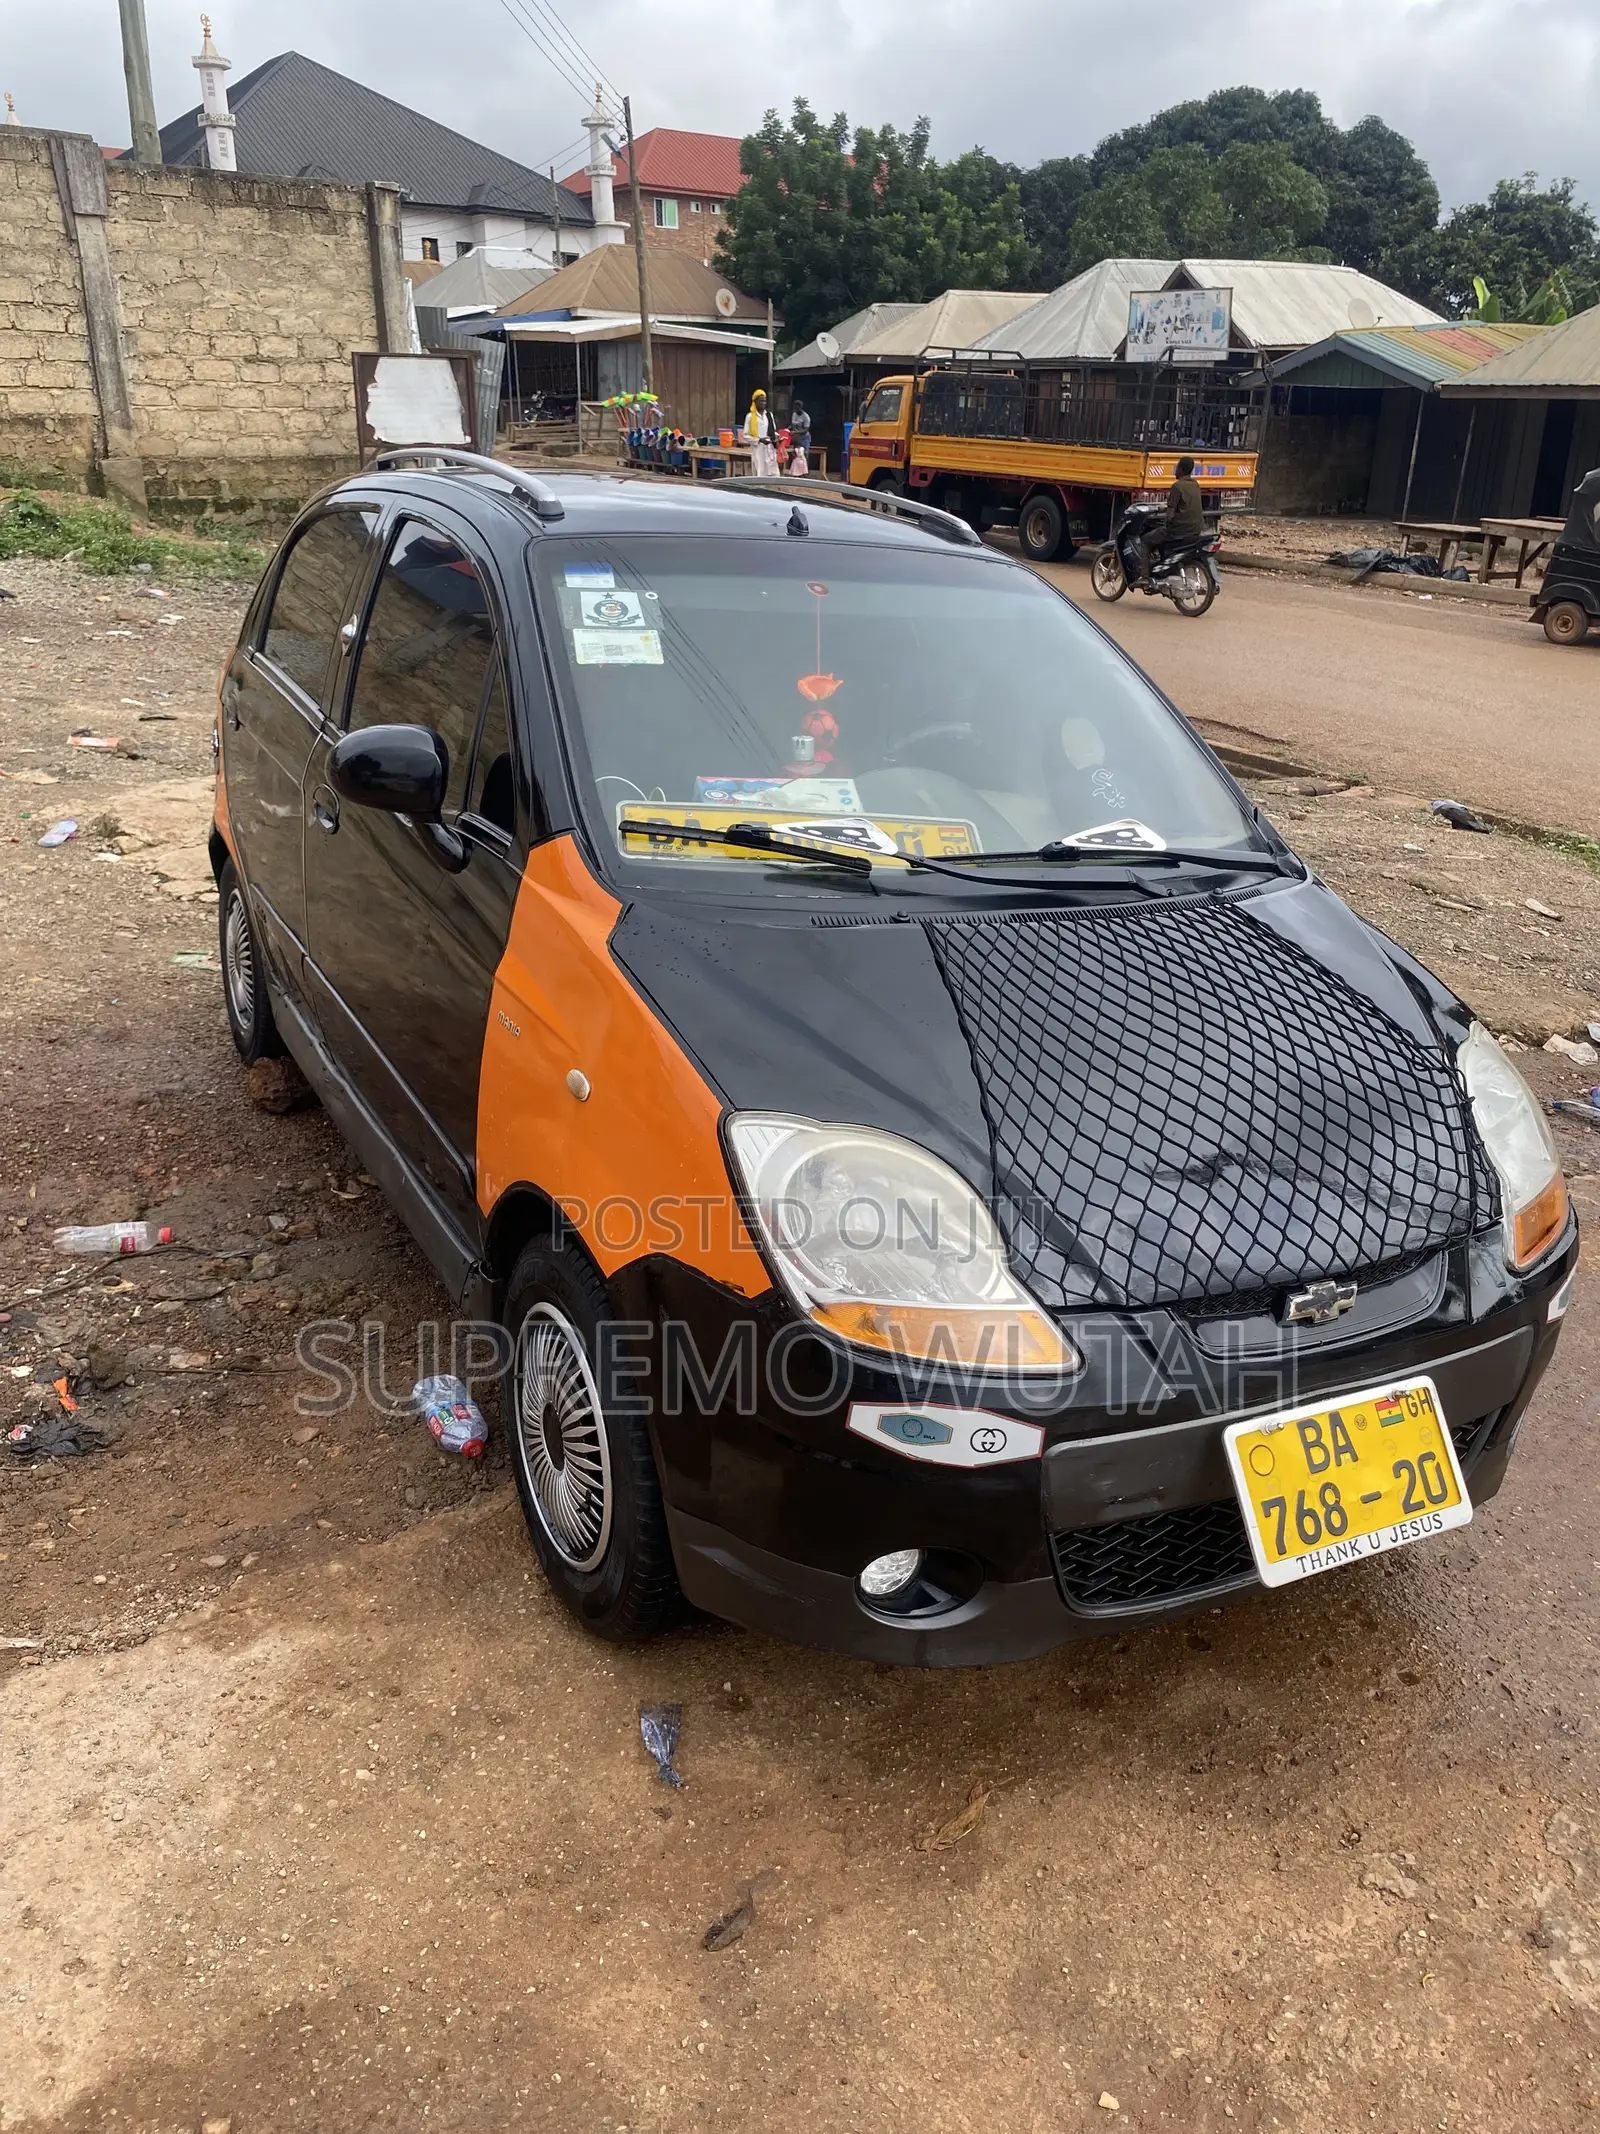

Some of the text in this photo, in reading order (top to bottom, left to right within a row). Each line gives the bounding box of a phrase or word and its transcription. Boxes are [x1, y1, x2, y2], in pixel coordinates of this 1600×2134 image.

[1405, 1386, 1434, 1418] GH
[1296, 1410, 1359, 1474] BA
[1261, 1482, 1349, 1555] 768
[1392, 1451, 1448, 1515] 20
[1296, 1513, 1444, 1574] THANK U JESUS
